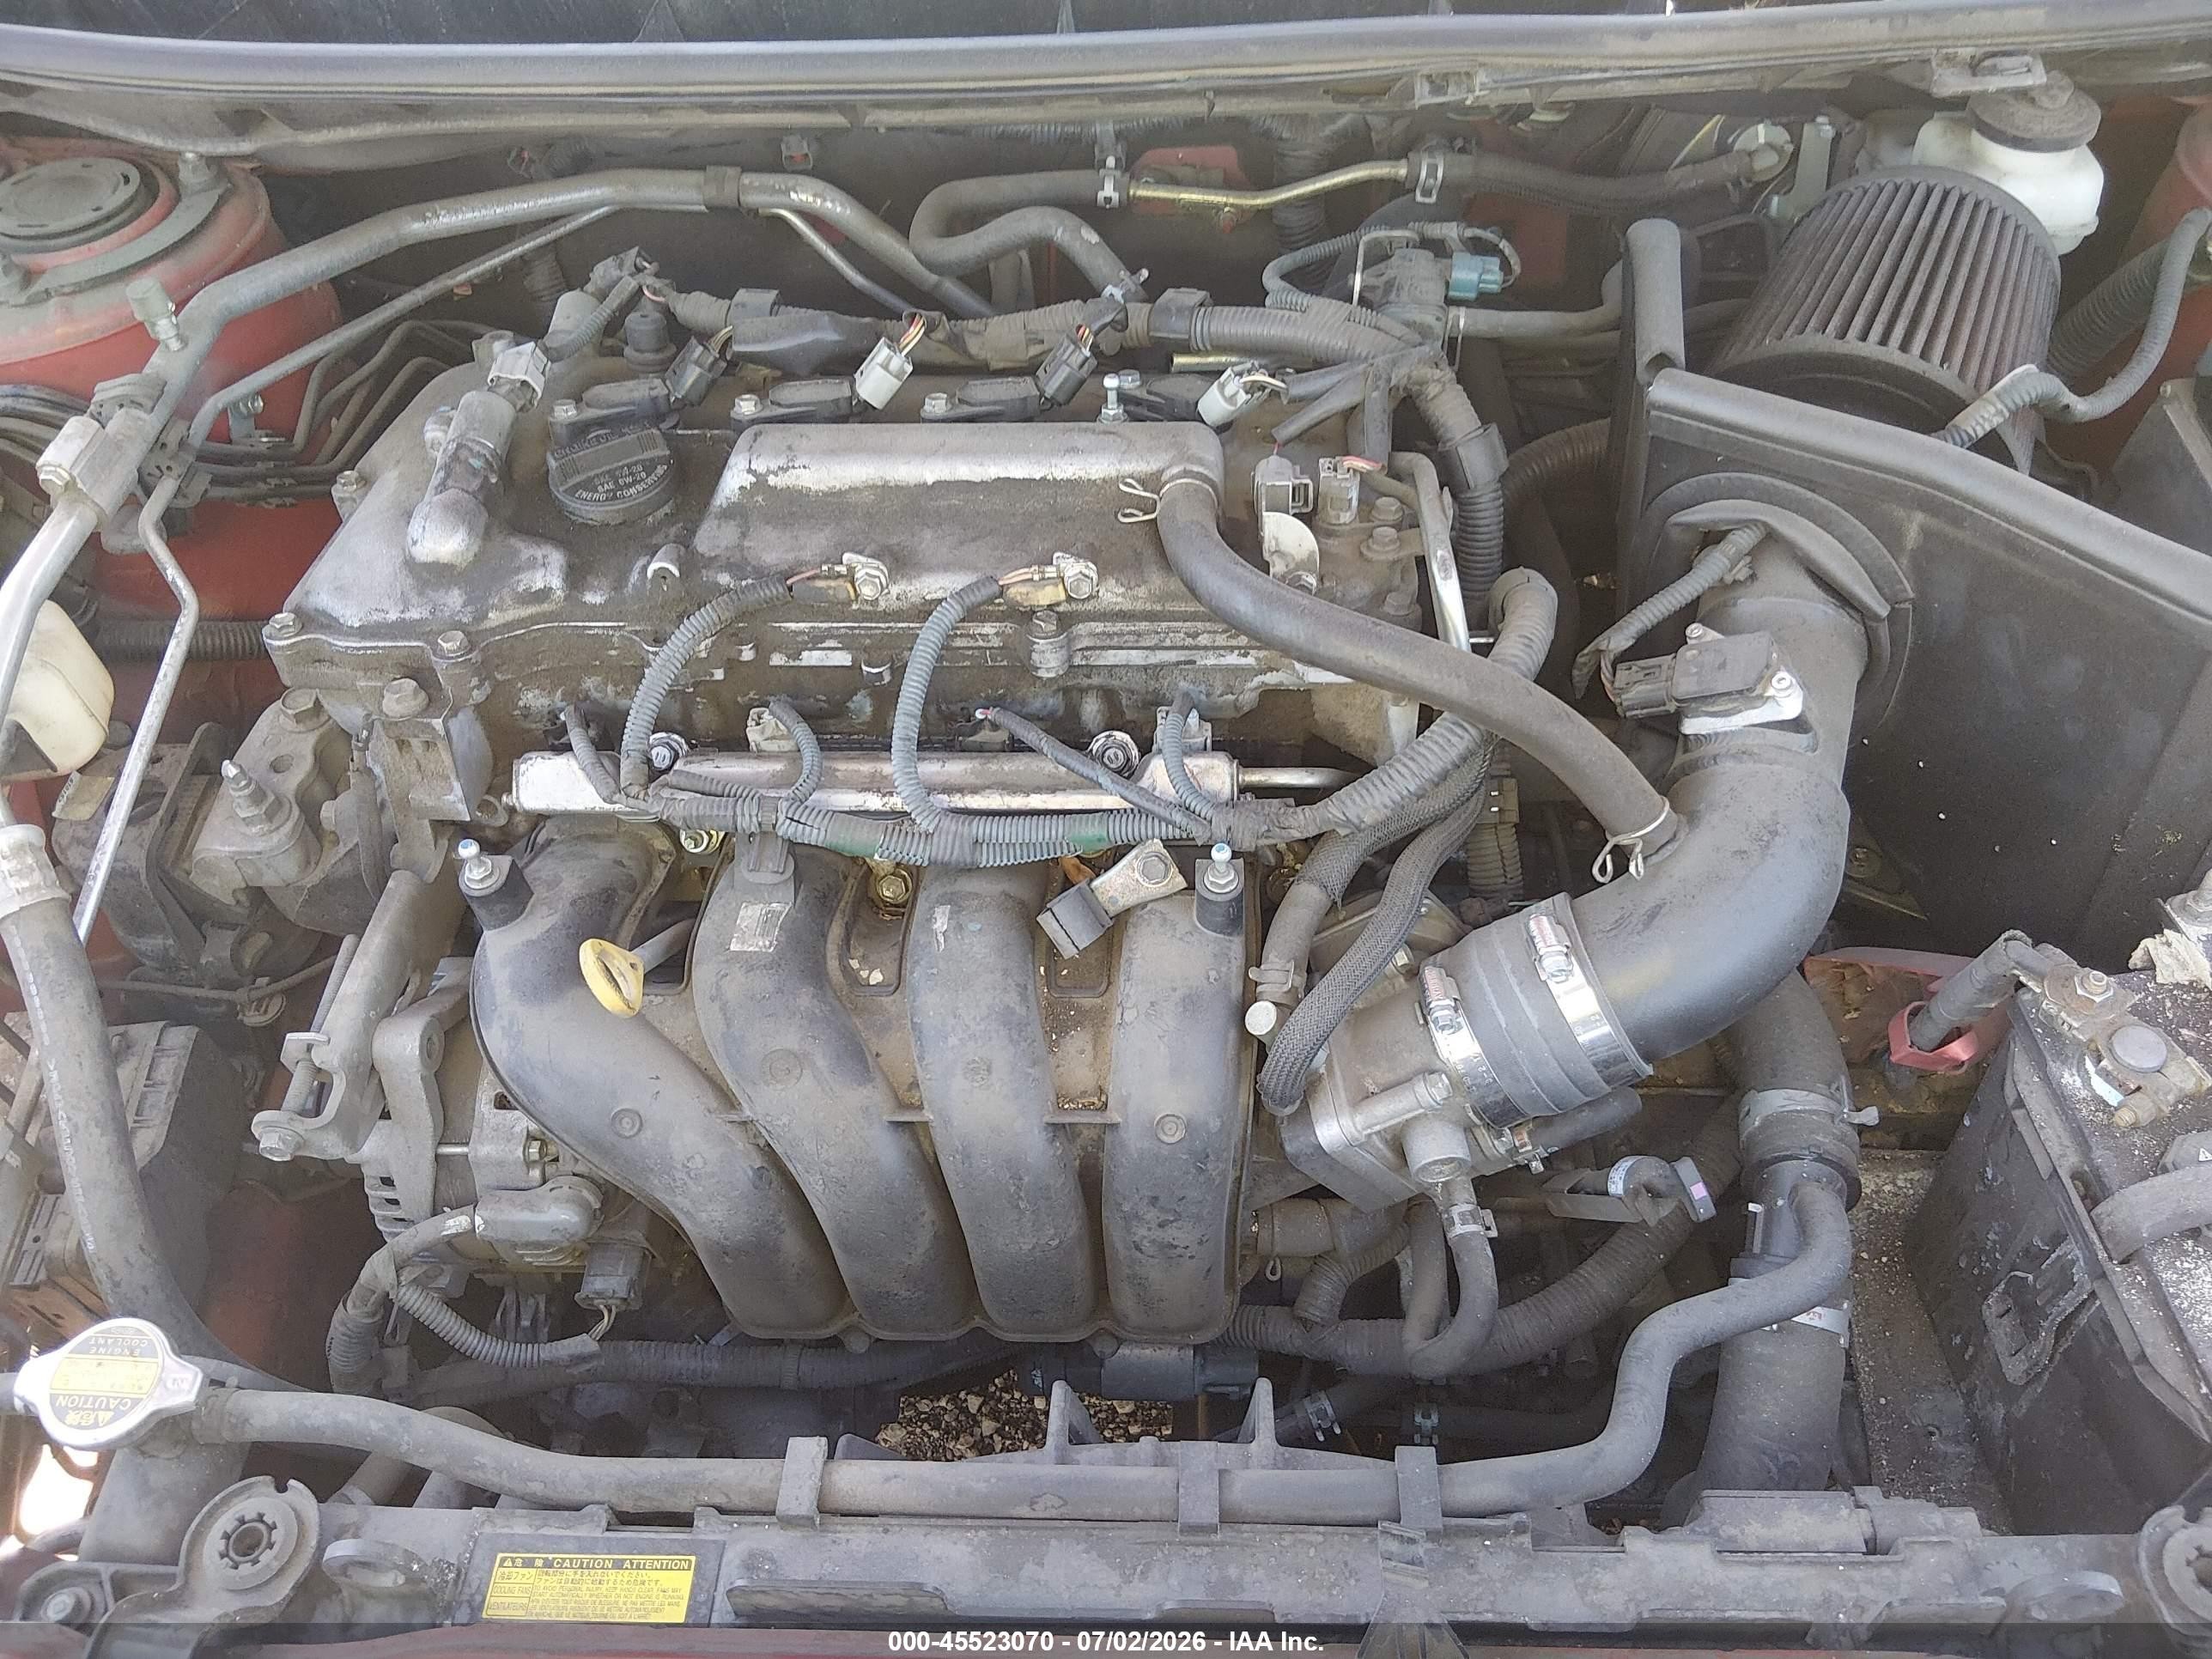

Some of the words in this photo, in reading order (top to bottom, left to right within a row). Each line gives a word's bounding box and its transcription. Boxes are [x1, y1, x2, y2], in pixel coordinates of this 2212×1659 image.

[598, 481, 615, 493] SAE
[618, 471, 647, 486] 0W-20
[89, 1337, 148, 1346] COOLANT
[89, 1346, 139, 1357] ENGINE
[56, 1395, 131, 1410] CAUTION
[553, 1559, 612, 1569] CAUTION
[623, 1559, 689, 1570] ATTENTION
